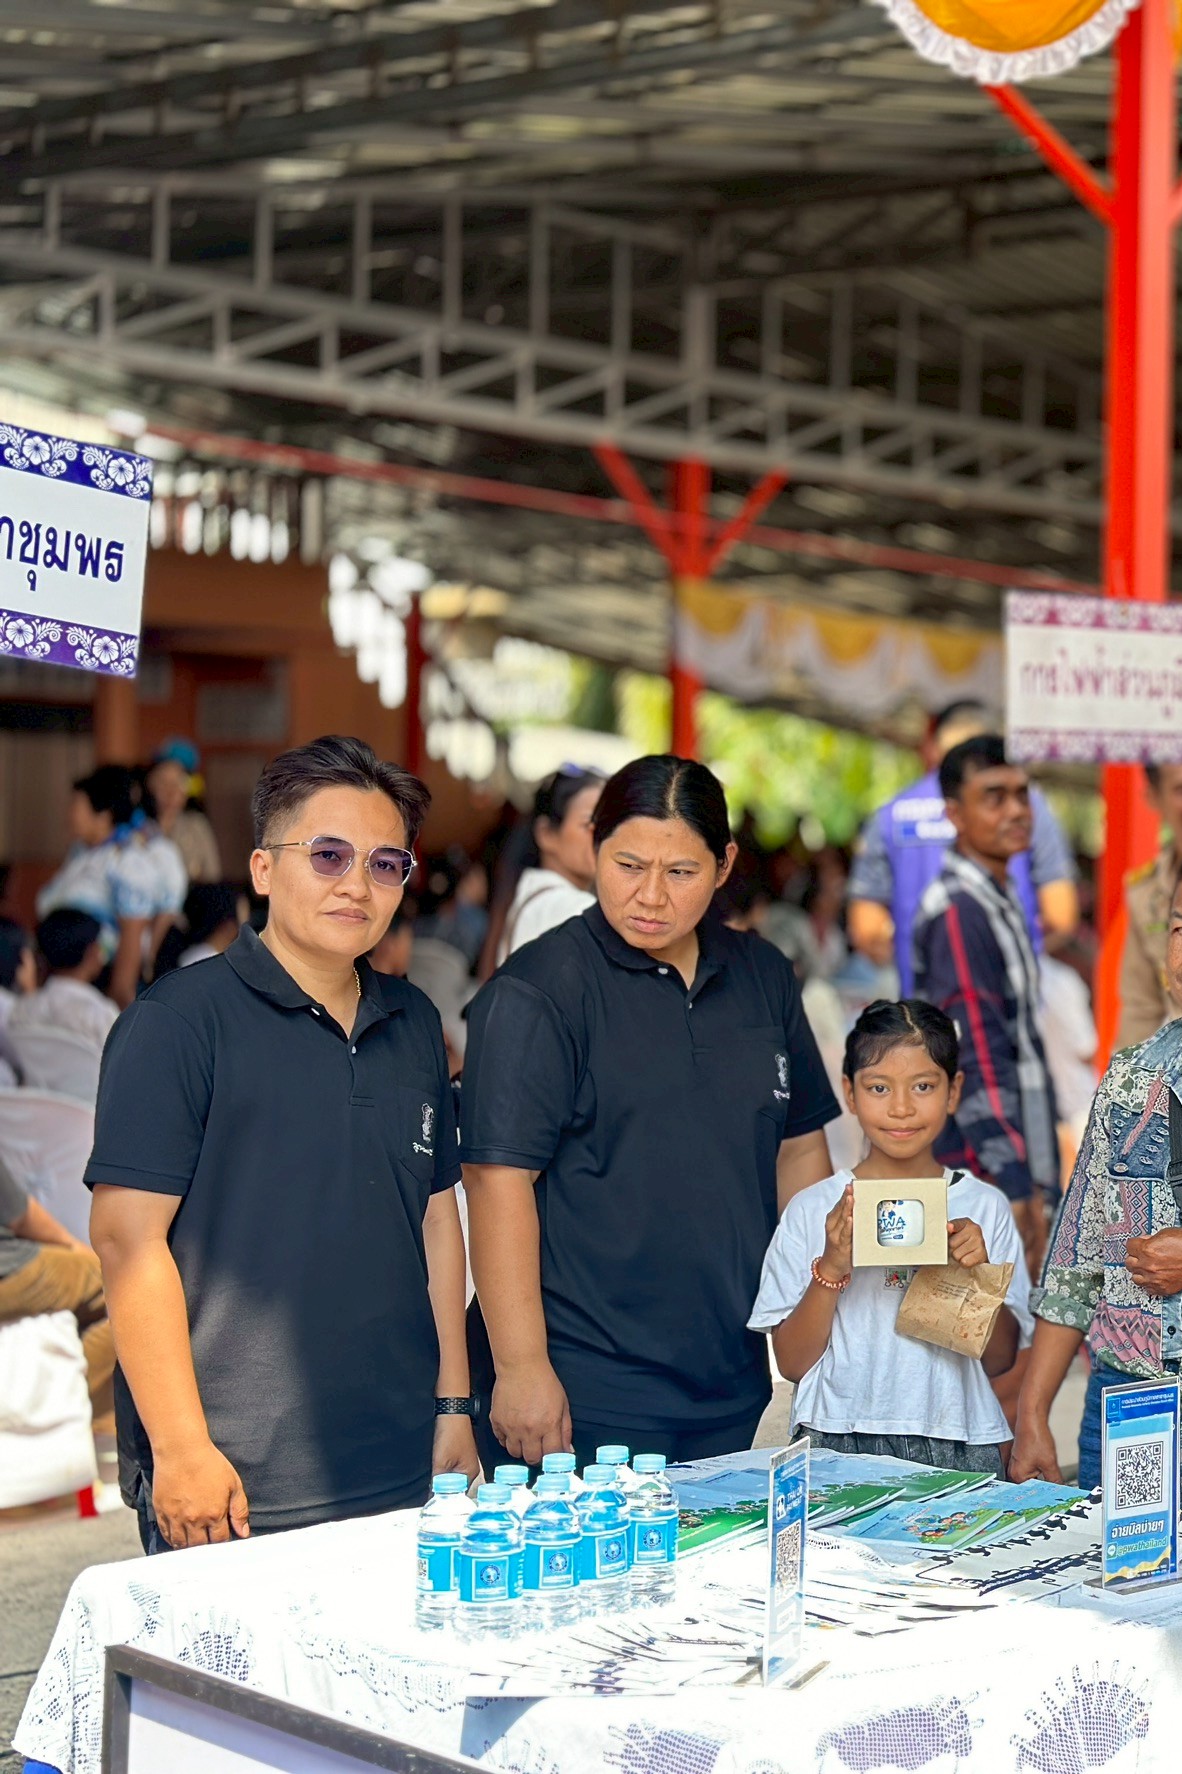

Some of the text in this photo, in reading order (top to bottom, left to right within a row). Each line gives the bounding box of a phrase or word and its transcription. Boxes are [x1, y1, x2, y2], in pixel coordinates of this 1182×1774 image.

[1111, 1519, 1165, 1539] จ่ายบิลง่ายๆ
[1117, 1538, 1167, 1555] @pwathailand
